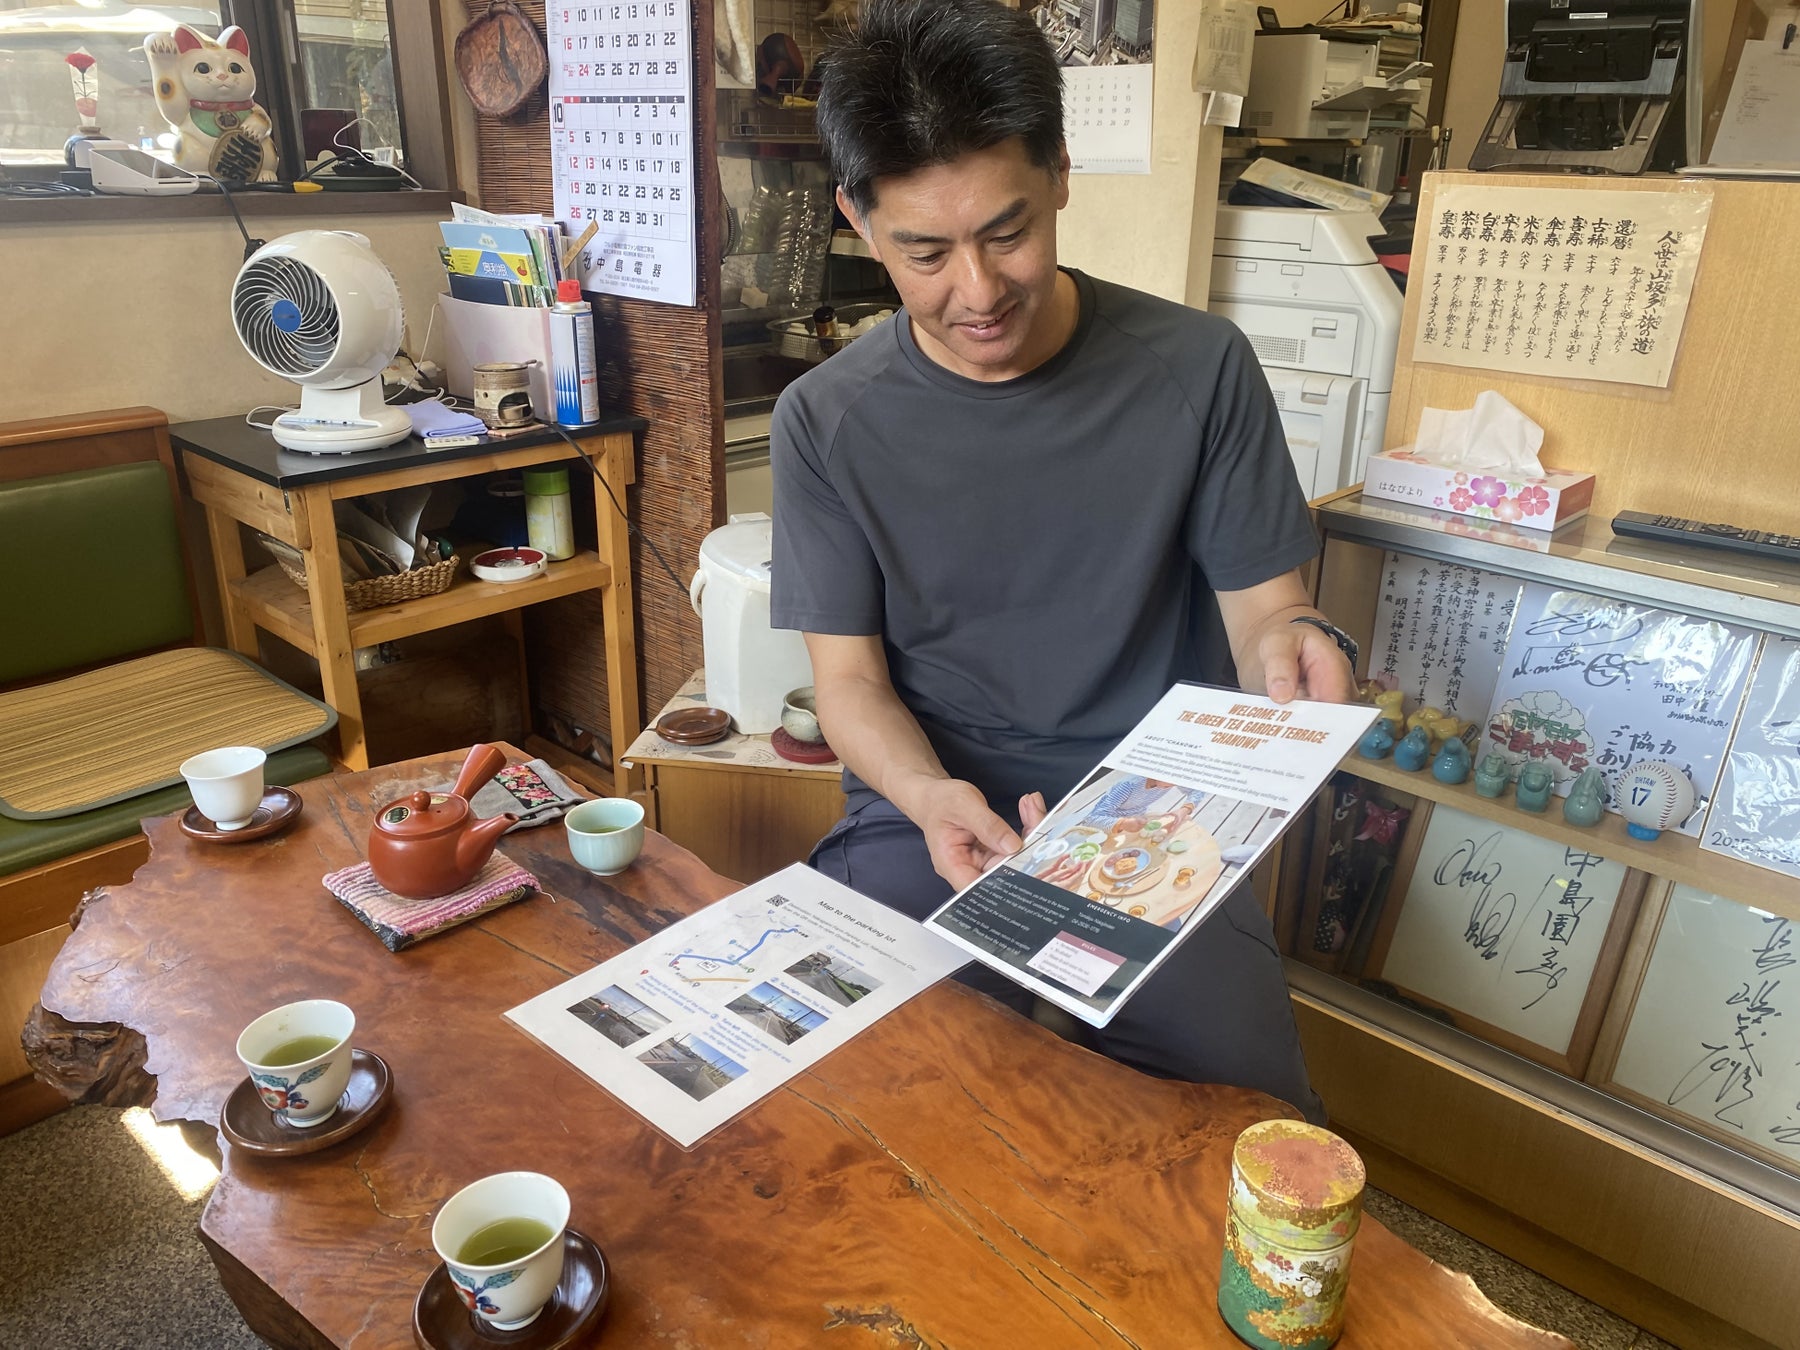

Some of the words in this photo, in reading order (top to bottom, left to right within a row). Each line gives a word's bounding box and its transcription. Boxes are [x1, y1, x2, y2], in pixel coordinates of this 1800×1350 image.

[564, 11, 568, 22] 9
[578, 9, 587, 21] 10
[593, 8, 602, 21] 11
[610, 6, 620, 20] 12
[628, 5, 638, 19] 13
[645, 3, 656, 17] 14
[664, 2, 674, 16] 15
[564, 37, 572, 50] 16
[578, 36, 588, 50] 17
[595, 36, 604, 48] 18
[611, 34, 621, 48] 19
[627, 34, 638, 47] 20
[645, 32, 656, 46] 21
[664, 32, 676, 46] 22
[579, 64, 589, 76] 24
[595, 63, 605, 76] 25
[612, 63, 622, 76] 26
[629, 62, 640, 75] 27
[647, 62, 658, 75] 28
[665, 61, 677, 74] 29
[554, 103, 563, 123] 10
[618, 105, 621, 117] 1
[634, 105, 640, 117] 2
[652, 105, 658, 117] 3
[670, 105, 676, 117] 4
[569, 131, 574, 143] 5
[585, 131, 590, 143] 6
[602, 132, 607, 144] 7
[618, 132, 624, 144] 8
[636, 132, 641, 145] 9
[652, 133, 662, 145] 10
[670, 133, 679, 146] 11
[569, 157, 578, 168] 12
[585, 157, 594, 169] 13
[602, 158, 611, 170] 14
[618, 159, 628, 171] 15
[636, 159, 645, 172] 16
[653, 160, 662, 173] 17
[670, 161, 680, 173] 18
[570, 182, 580, 194] 19
[586, 183, 596, 195] 20
[602, 184, 612, 196] 21
[618, 185, 629, 197] 22
[636, 186, 646, 198] 23
[652, 187, 663, 200] 24
[670, 188, 680, 201] 25
[571, 207, 580, 219] 26
[587, 208, 597, 220] 27
[603, 210, 613, 221] 28
[620, 211, 630, 223] 29
[636, 212, 646, 225] 30
[653, 214, 663, 226] 31
[1438, 210, 1454, 239] 皇寿
[1458, 210, 1476, 240] 茶寿
[1480, 211, 1496, 242] 白寿
[1522, 215, 1539, 245] 米寿
[1567, 215, 1584, 246] 喜寿
[1587, 217, 1609, 248] 古稀
[1610, 219, 1632, 250] 還暦
[1379, 482, 1422, 496] はなびより
[1662, 694, 1686, 707] 田中
[1228, 704, 1276, 720] WELCOME
[1276, 711, 1292, 722] TO
[1178, 710, 1198, 722] THE
[1194, 713, 1226, 728] GREEN
[1224, 718, 1245, 730] TEA
[1241, 721, 1283, 737] GARDEN
[1281, 727, 1330, 744] TERRACE
[1607, 725, 1677, 756] ご協力
[1634, 776, 1657, 787] OHTANI
[1631, 786, 1652, 807] 17
[816, 900, 836, 911] Map
[842, 913, 857, 922] the
[854, 920, 885, 938] parking
[883, 934, 897, 943] lot
[1086, 904, 1116, 918] EMERGENCY
[1116, 915, 1131, 923] INFO
